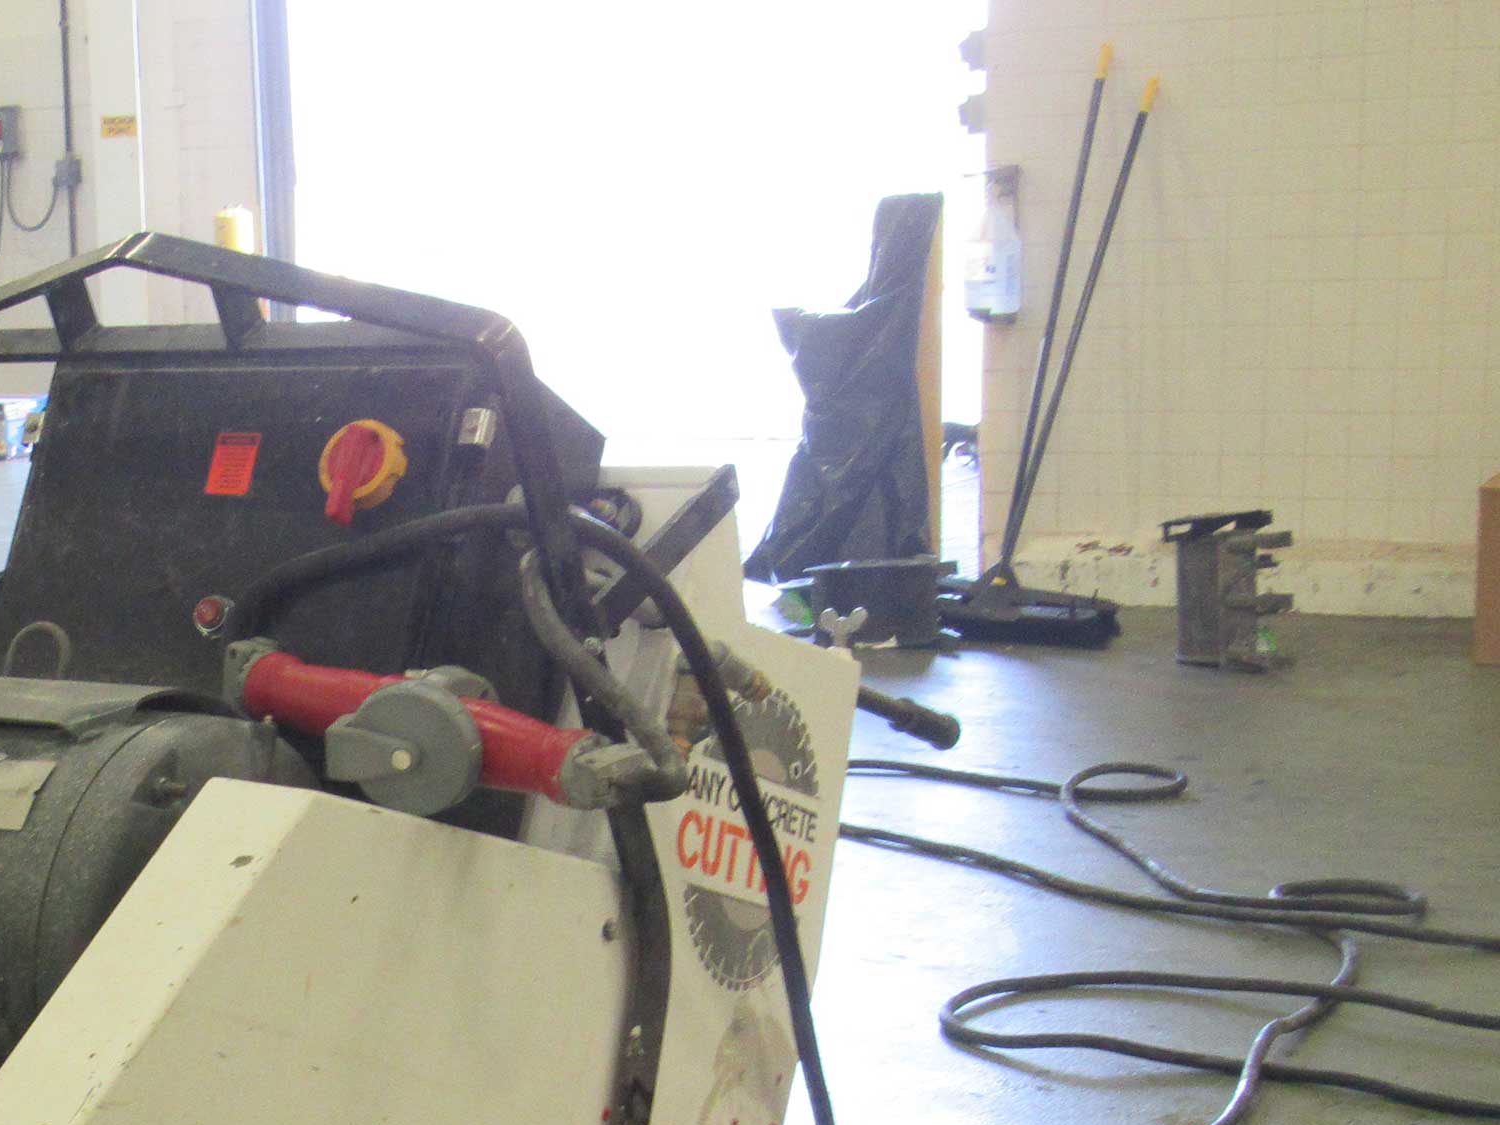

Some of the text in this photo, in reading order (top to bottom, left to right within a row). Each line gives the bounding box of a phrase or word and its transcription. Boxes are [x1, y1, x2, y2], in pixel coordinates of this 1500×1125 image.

[685, 764, 819, 844] ANY CCRETE
[676, 809, 812, 905] CUTTG
